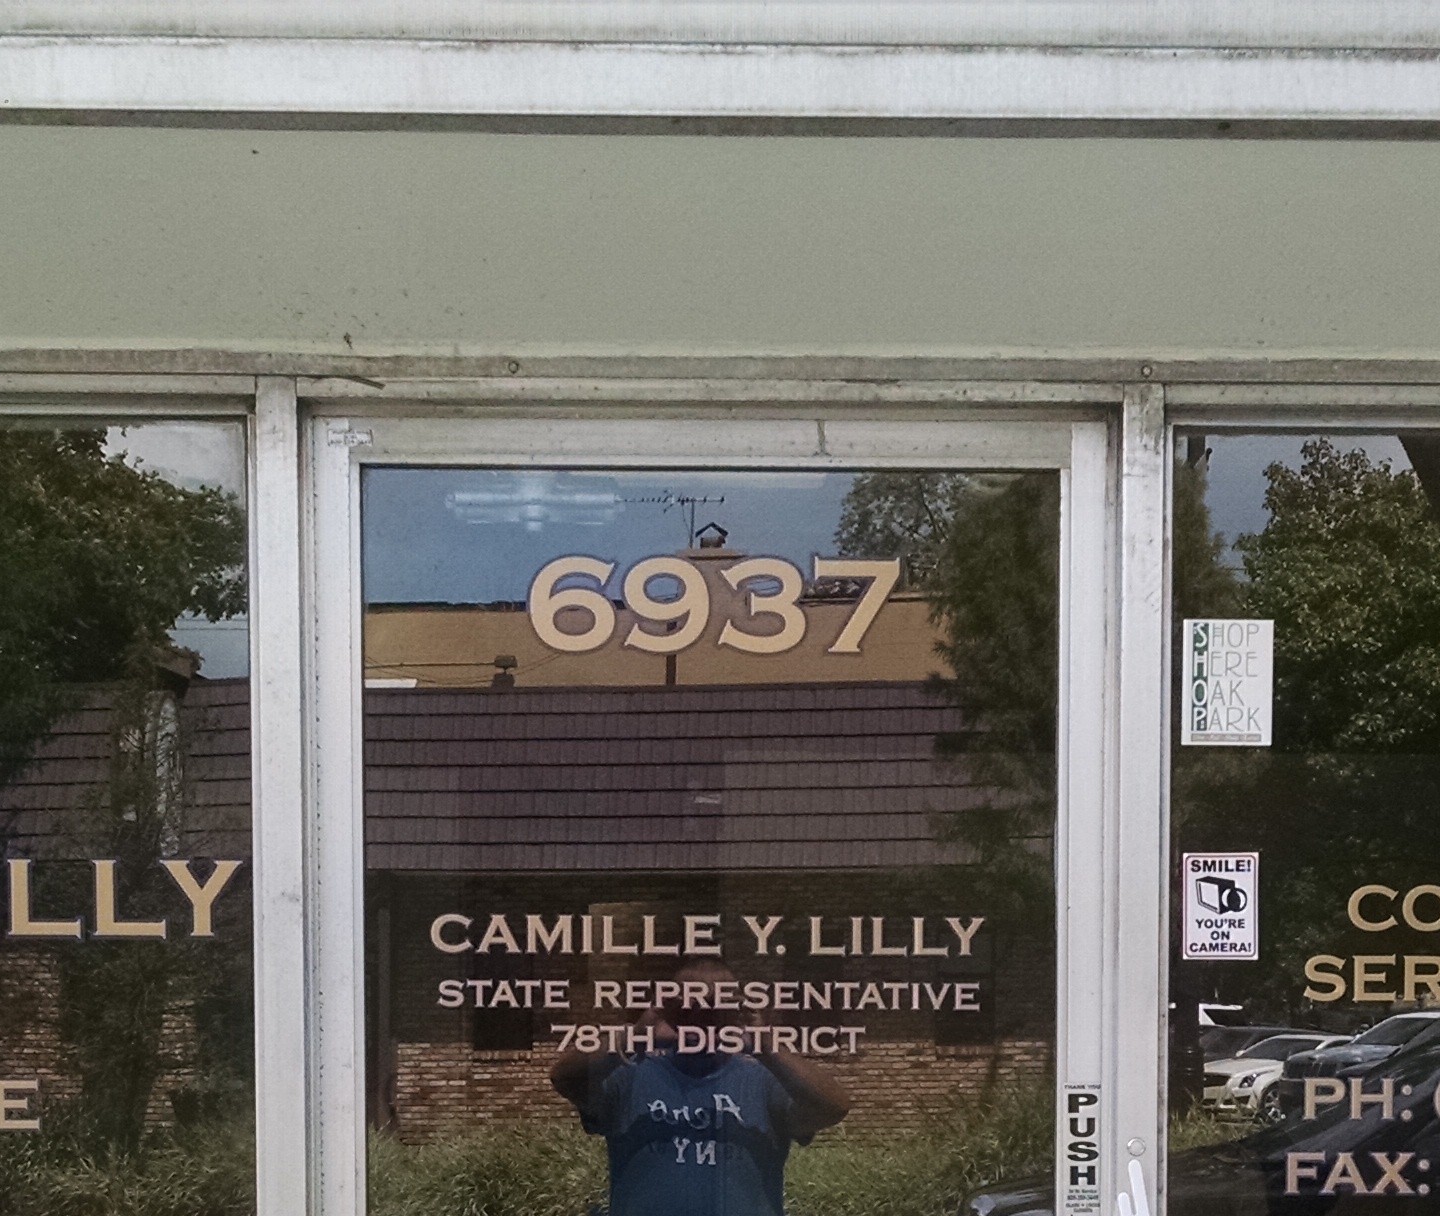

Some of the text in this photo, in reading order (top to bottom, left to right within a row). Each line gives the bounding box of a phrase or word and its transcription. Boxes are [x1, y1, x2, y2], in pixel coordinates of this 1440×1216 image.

[528, 555, 901, 654] 6937
[1193, 622, 1260, 648] SHOP
[1192, 679, 1244, 707] OAK
[1191, 707, 1261, 732] PARK
[1190, 859, 1251, 873] SMILE!
[430, 913, 985, 957] CAMILLE Y. LILLY
[1195, 918, 1246, 929] YOU'RE
[1210, 930, 1231, 941] ON
[1189, 942, 1252, 953] CAMERA!
[438, 979, 982, 1012] STATE REPRESENTATIVE
[550, 1024, 867, 1055] 78TH DISTRICT
[1302, 1077, 1414, 1122] PH:
[1067, 1093, 1099, 1186] PUSH
[1283, 1152, 1430, 1196] FAX:
